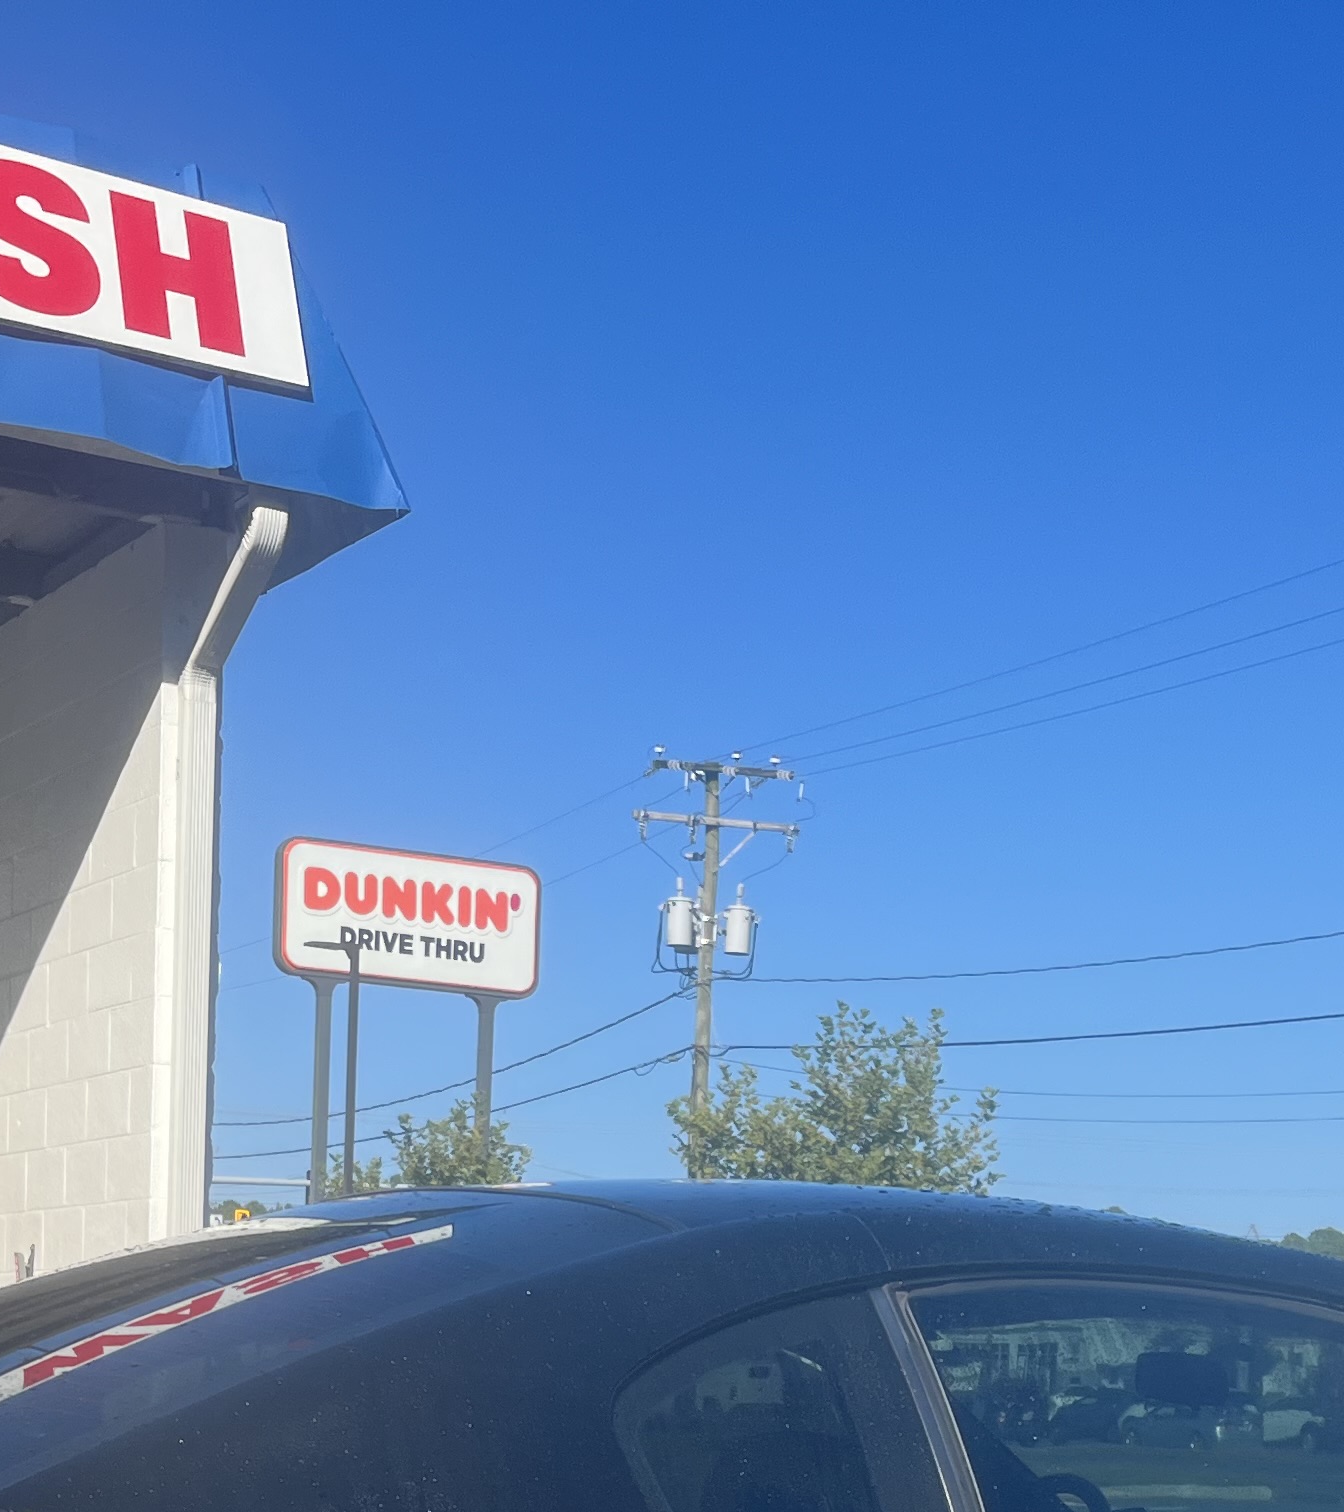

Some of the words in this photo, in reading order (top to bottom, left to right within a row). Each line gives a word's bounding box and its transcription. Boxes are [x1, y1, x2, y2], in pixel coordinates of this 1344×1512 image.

[304, 866, 521, 932] DUNKIN'
[340, 926, 414, 956] DRIVE
[420, 935, 485, 963] THRU
